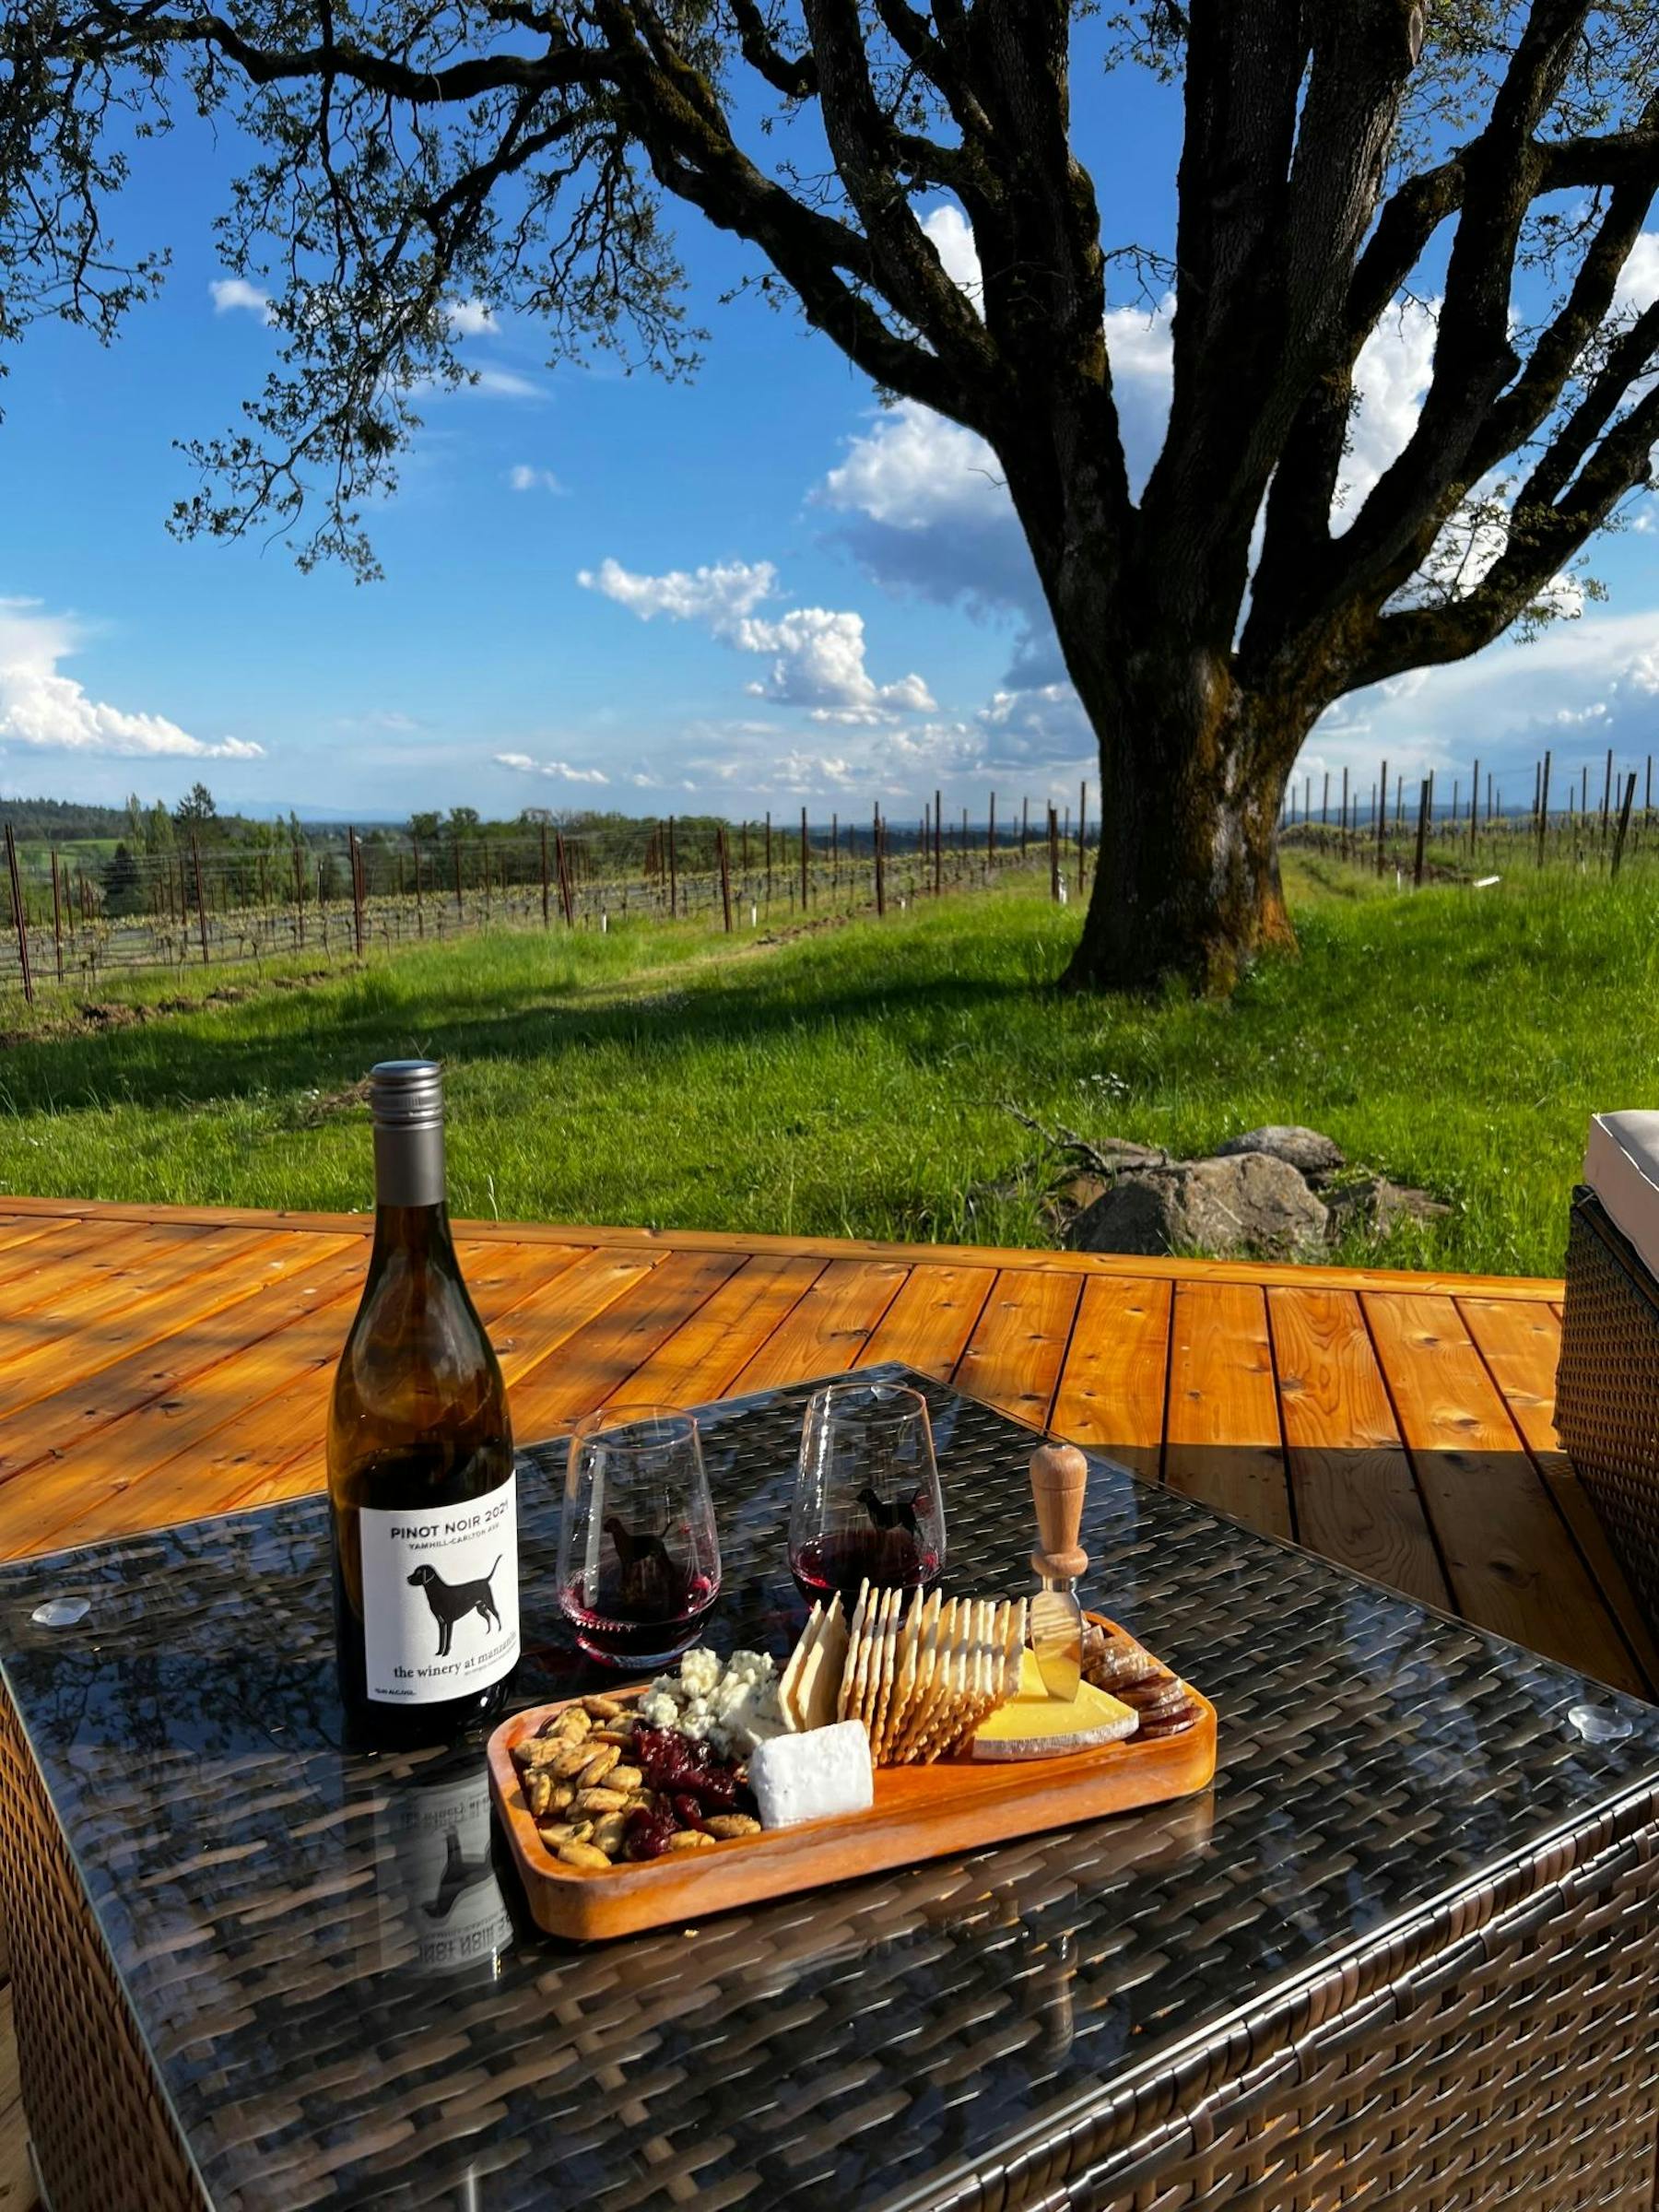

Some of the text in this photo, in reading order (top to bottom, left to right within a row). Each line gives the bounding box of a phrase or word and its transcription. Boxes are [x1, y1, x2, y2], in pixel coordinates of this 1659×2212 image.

[391, 1525, 440, 1539] PINOT
[444, 1514, 481, 1535] NOIR
[394, 1665, 414, 1678] the
[418, 1661, 462, 1677] winery
[465, 1657, 475, 1669] at
